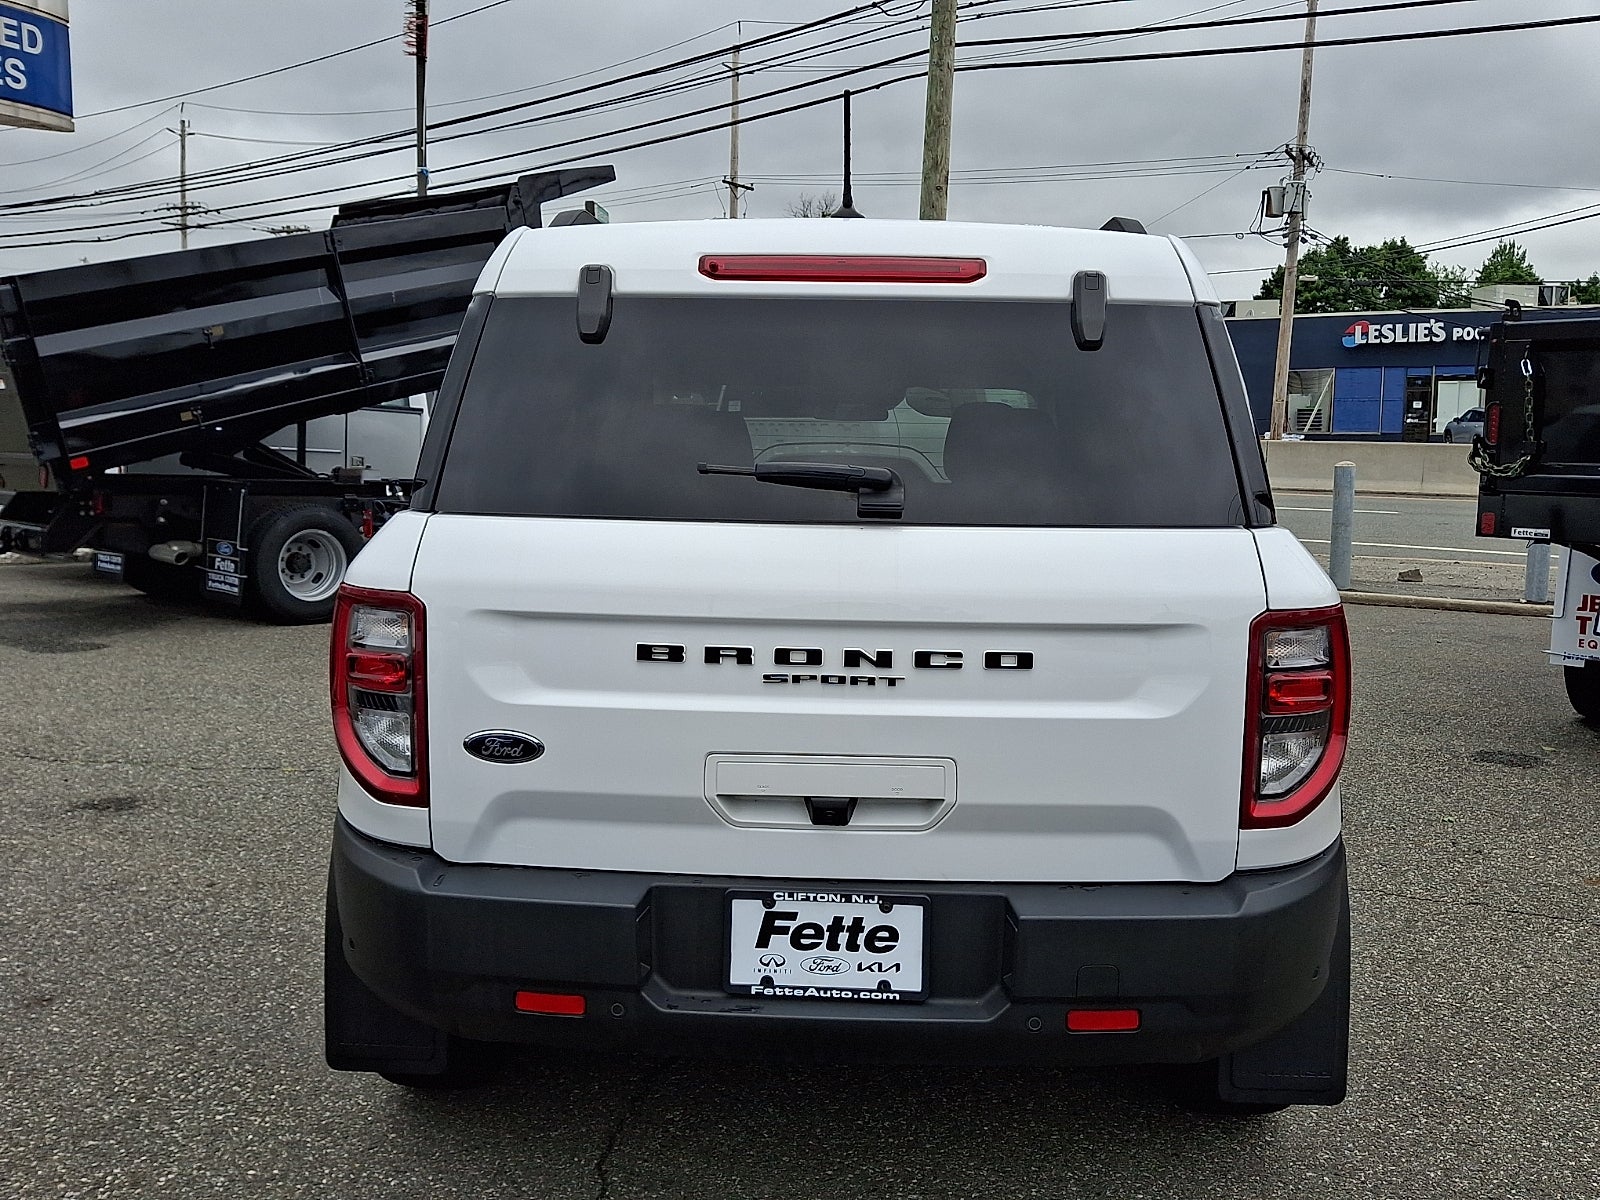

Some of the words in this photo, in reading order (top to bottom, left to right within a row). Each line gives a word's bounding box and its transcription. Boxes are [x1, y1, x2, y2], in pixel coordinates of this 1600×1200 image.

[0, 56, 27, 90] S
[1354, 319, 1446, 344] LESLIE'S
[635, 642, 1034, 670] BRONCO
[761, 673, 905, 687] SPORT
[481, 737, 524, 757] Ford
[773, 892, 846, 904] CLIFTON,
[852, 894, 883, 904] N.J.
[754, 910, 900, 954] Fette
[753, 967, 792, 975] INFINITI
[808, 956, 842, 973] Ford
[751, 985, 900, 1000] FetteAuto.com
